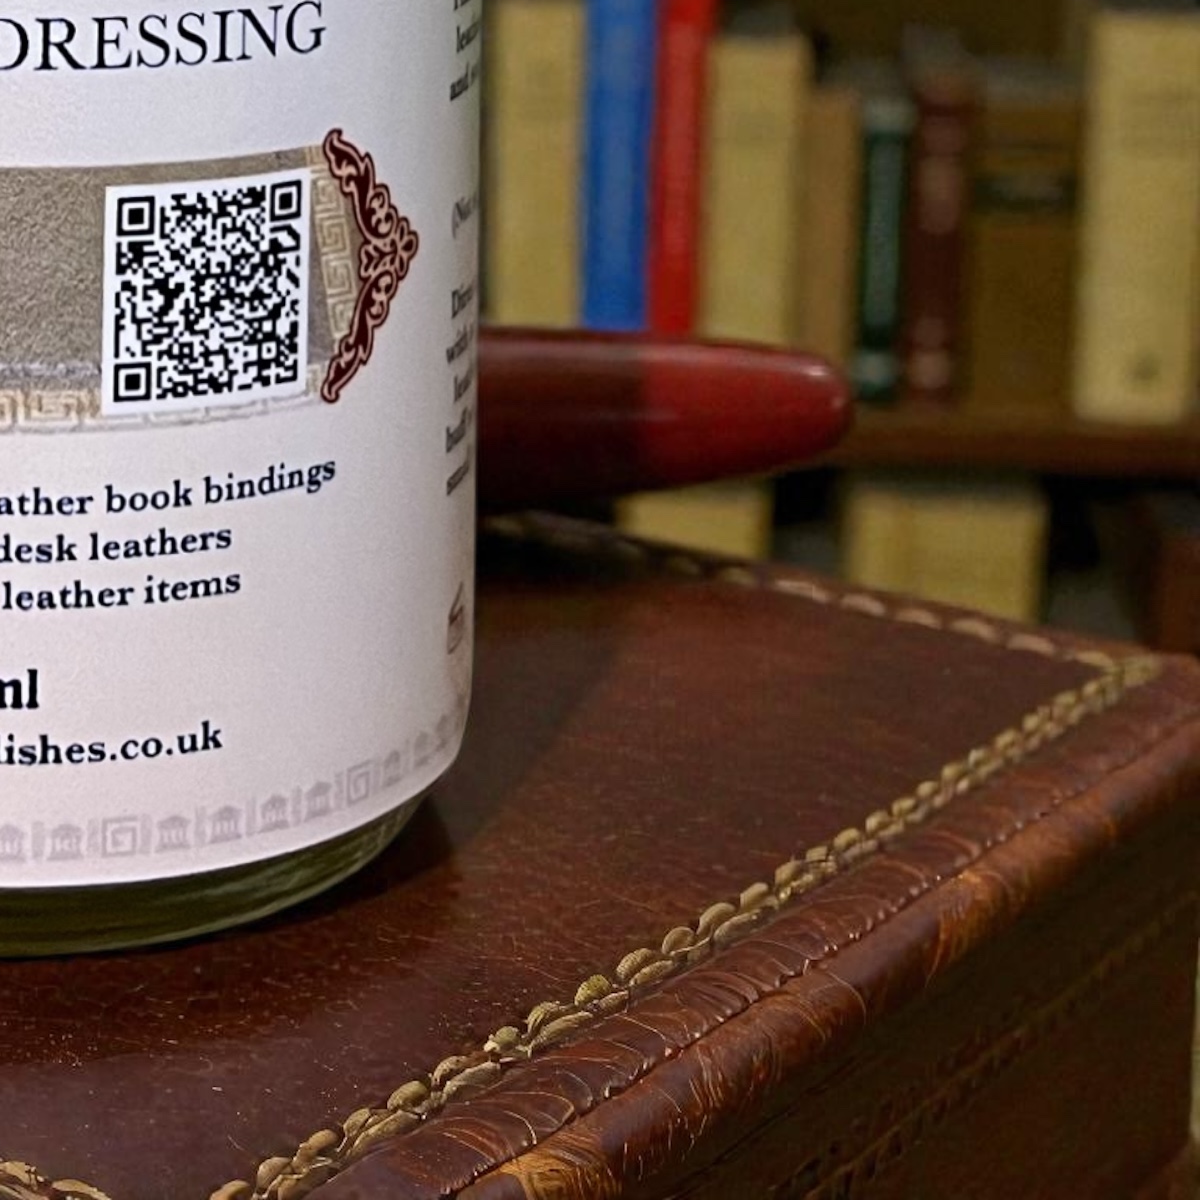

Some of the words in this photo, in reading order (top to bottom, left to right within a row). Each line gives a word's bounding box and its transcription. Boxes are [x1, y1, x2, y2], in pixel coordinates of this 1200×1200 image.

[103, 479, 194, 513] book
[202, 457, 337, 505] bindings
[87, 524, 233, 563] leathers
[1, 578, 136, 612] leather
[143, 568, 242, 605] items
